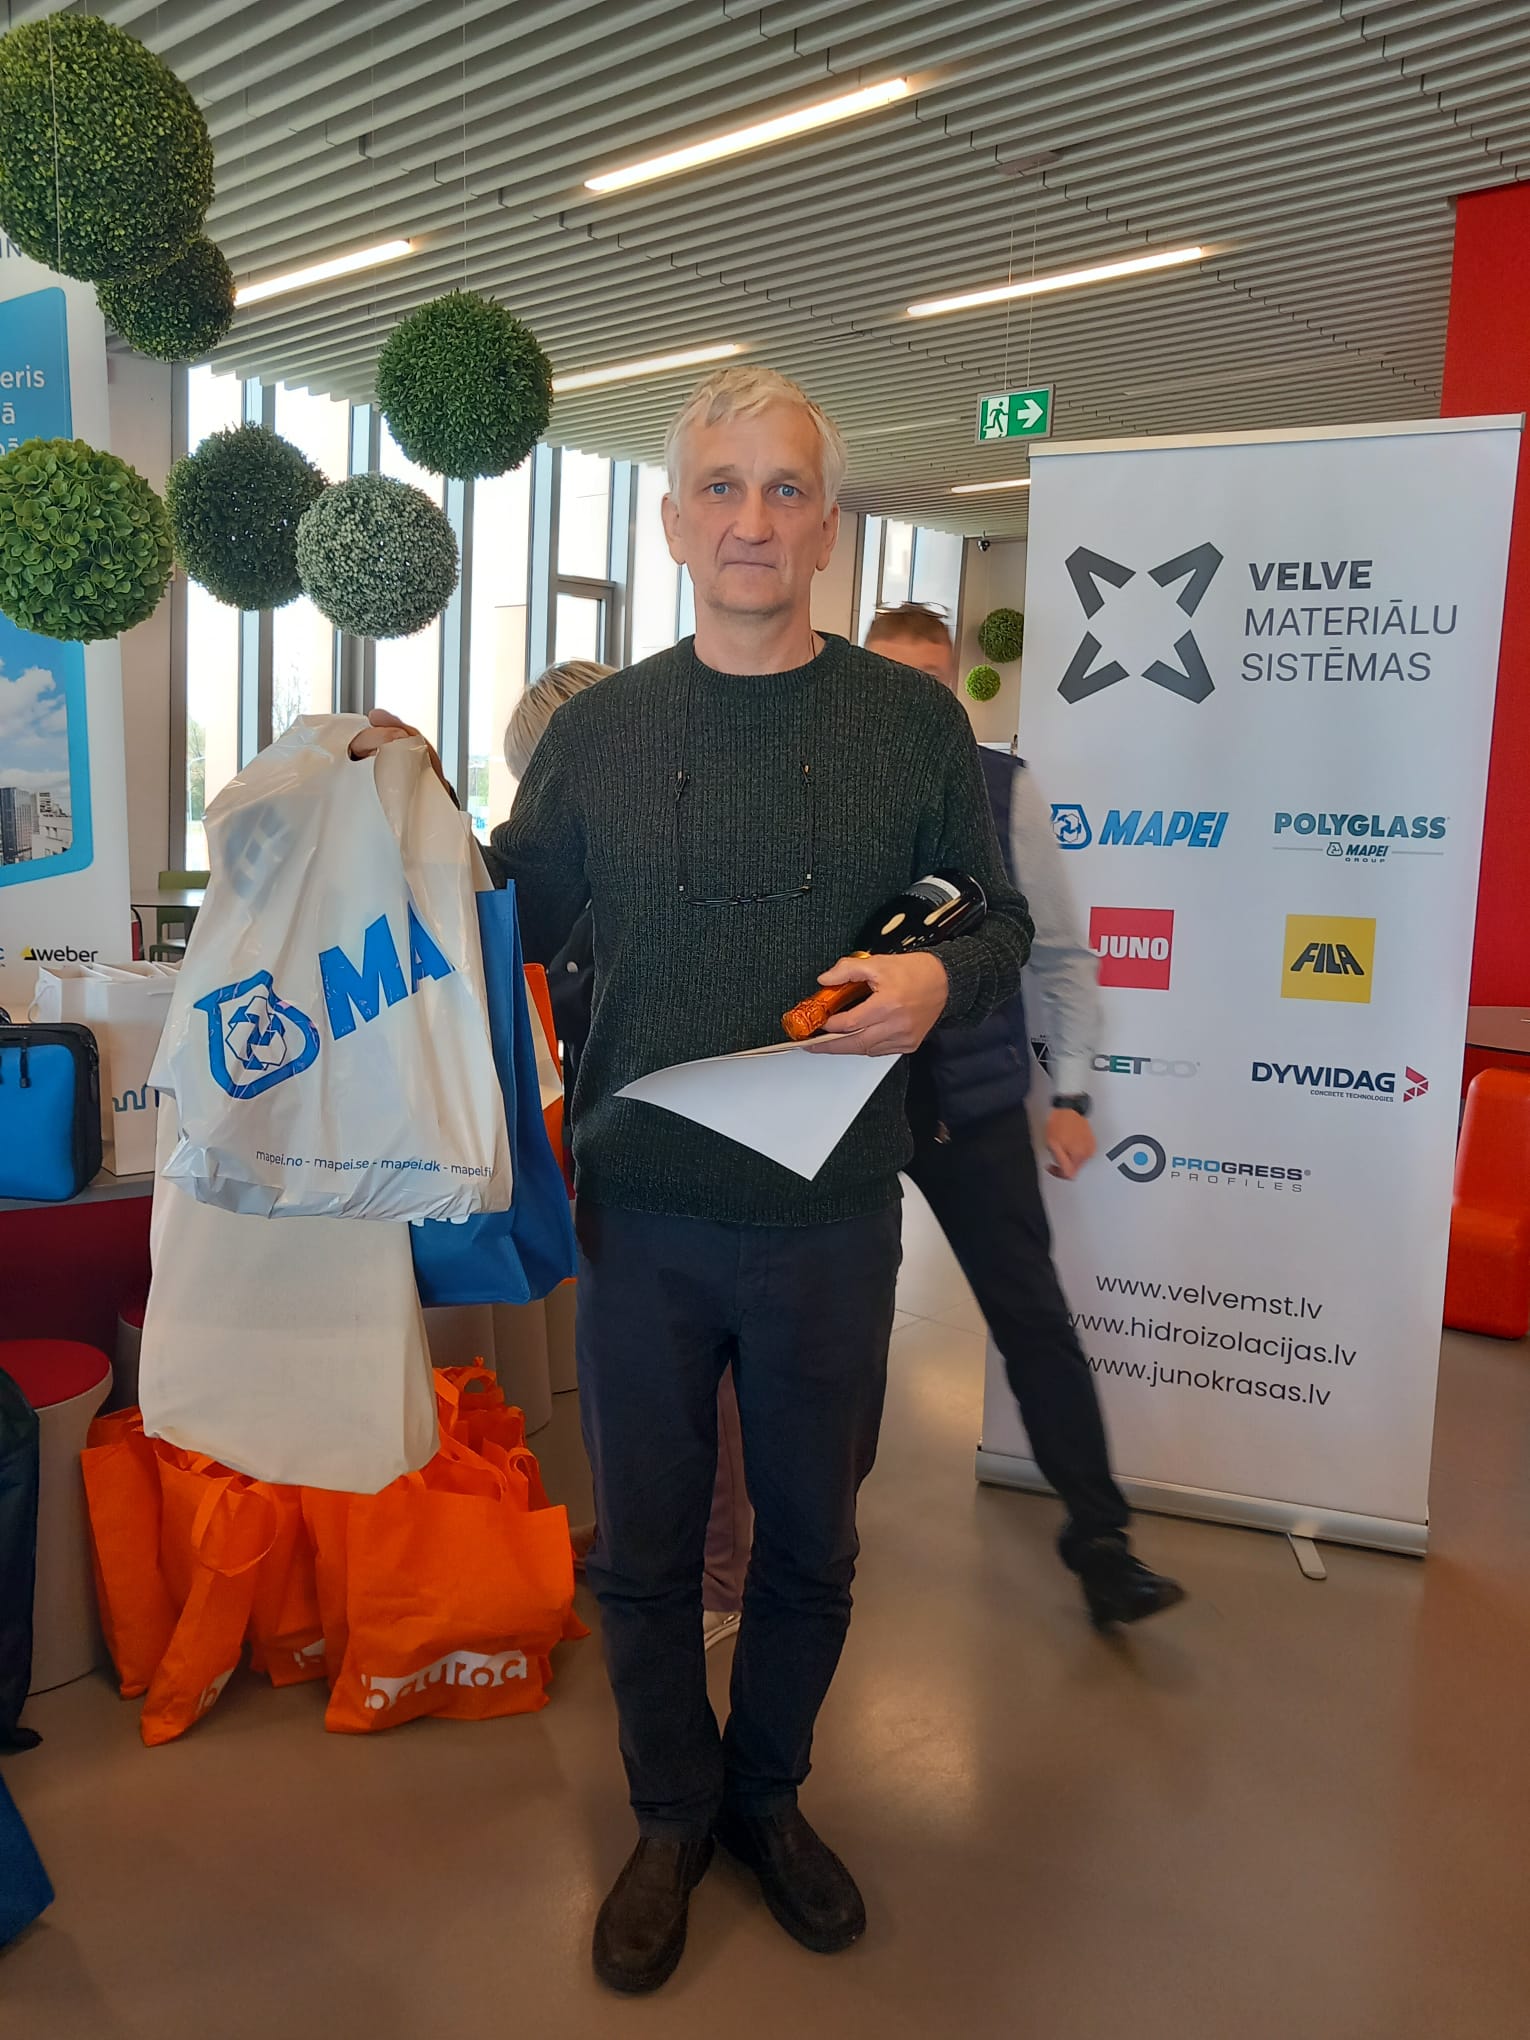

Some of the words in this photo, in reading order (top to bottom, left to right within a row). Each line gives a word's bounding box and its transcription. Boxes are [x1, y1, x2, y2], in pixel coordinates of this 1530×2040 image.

[1248, 559, 1374, 591] VELVE
[1244, 599, 1459, 637] MATERIĀLU
[1241, 646, 1432, 682] SISTĒMAS
[1098, 809, 1230, 849] MAPEI
[1273, 812, 1447, 840] POLYGLASS
[1345, 844, 1390, 857] MAPEI
[36, 945, 99, 963] weber
[1094, 935, 1170, 961] JUNO
[1290, 942, 1365, 976] FILA
[318, 901, 457, 1041] MA
[1251, 1061, 1396, 1094] DYWIDAG
[1310, 1089, 1345, 1098] CONCRETE
[1345, 1092, 1395, 1103] TECHNOLOGIES
[256, 1149, 303, 1167] mapei.no
[380, 1158, 441, 1172] mapei.dk
[1171, 1156, 1303, 1182] PROGRESS
[1170, 1171, 1303, 1193] PROFILES
[1096, 1275, 1324, 1321] www.velvemst.lv
